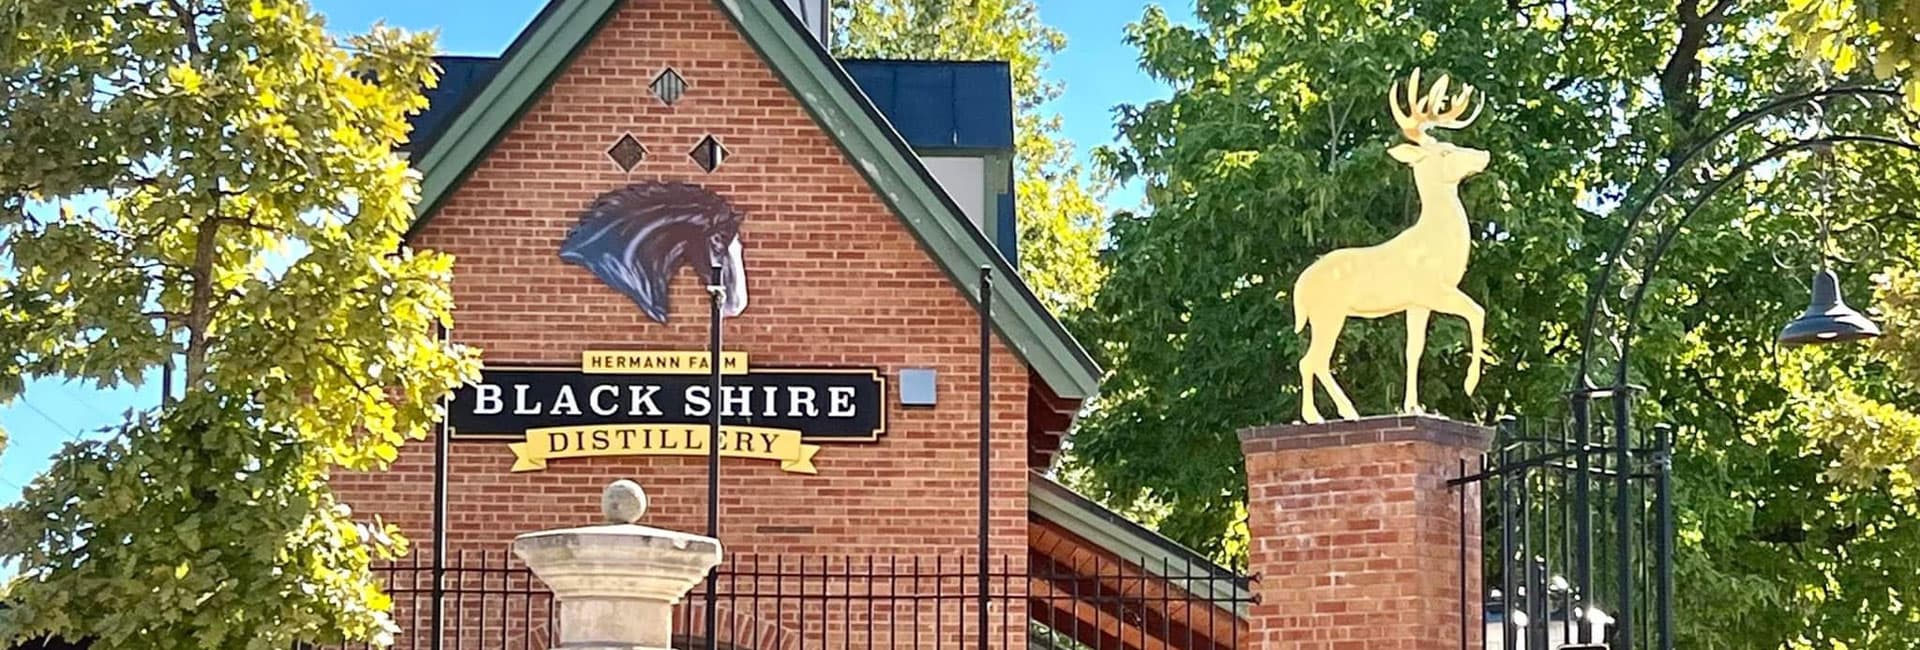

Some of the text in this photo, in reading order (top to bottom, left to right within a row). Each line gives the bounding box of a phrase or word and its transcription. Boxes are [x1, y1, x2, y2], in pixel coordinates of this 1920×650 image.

[591, 356, 736, 369] HERMANN FAM
[473, 384, 856, 417] BLACK SHIRE
